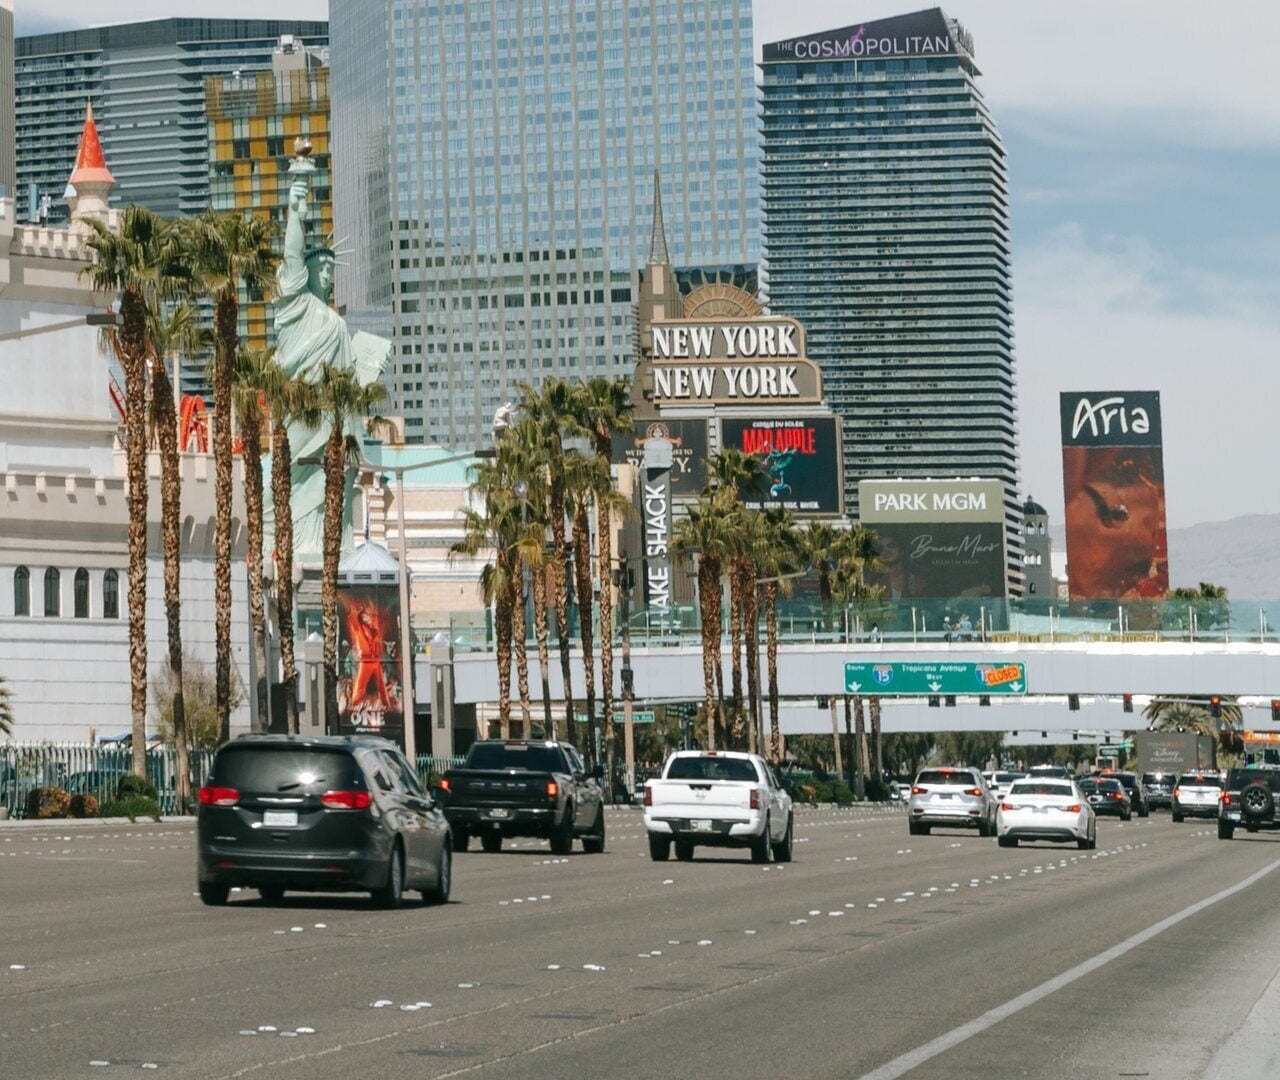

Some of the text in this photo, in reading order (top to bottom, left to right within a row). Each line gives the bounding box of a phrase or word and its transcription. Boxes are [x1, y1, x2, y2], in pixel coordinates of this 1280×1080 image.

[777, 35, 949, 58] THE COSMOPOLITAN
[652, 325, 798, 358] NEW YORK
[653, 366, 800, 399] NEW YORK
[743, 427, 816, 454] MAD APPLE
[874, 492, 987, 511] PARK MGM
[645, 484, 668, 557] SHACK
[910, 533, 1000, 559] Bruno Mars
[878, 672, 890, 682] 15
[901, 664, 937, 673] Tropicana
[940, 664, 967, 672] Avenue
[987, 667, 1019, 684] CLOSED
[351, 711, 386, 726] ONE
